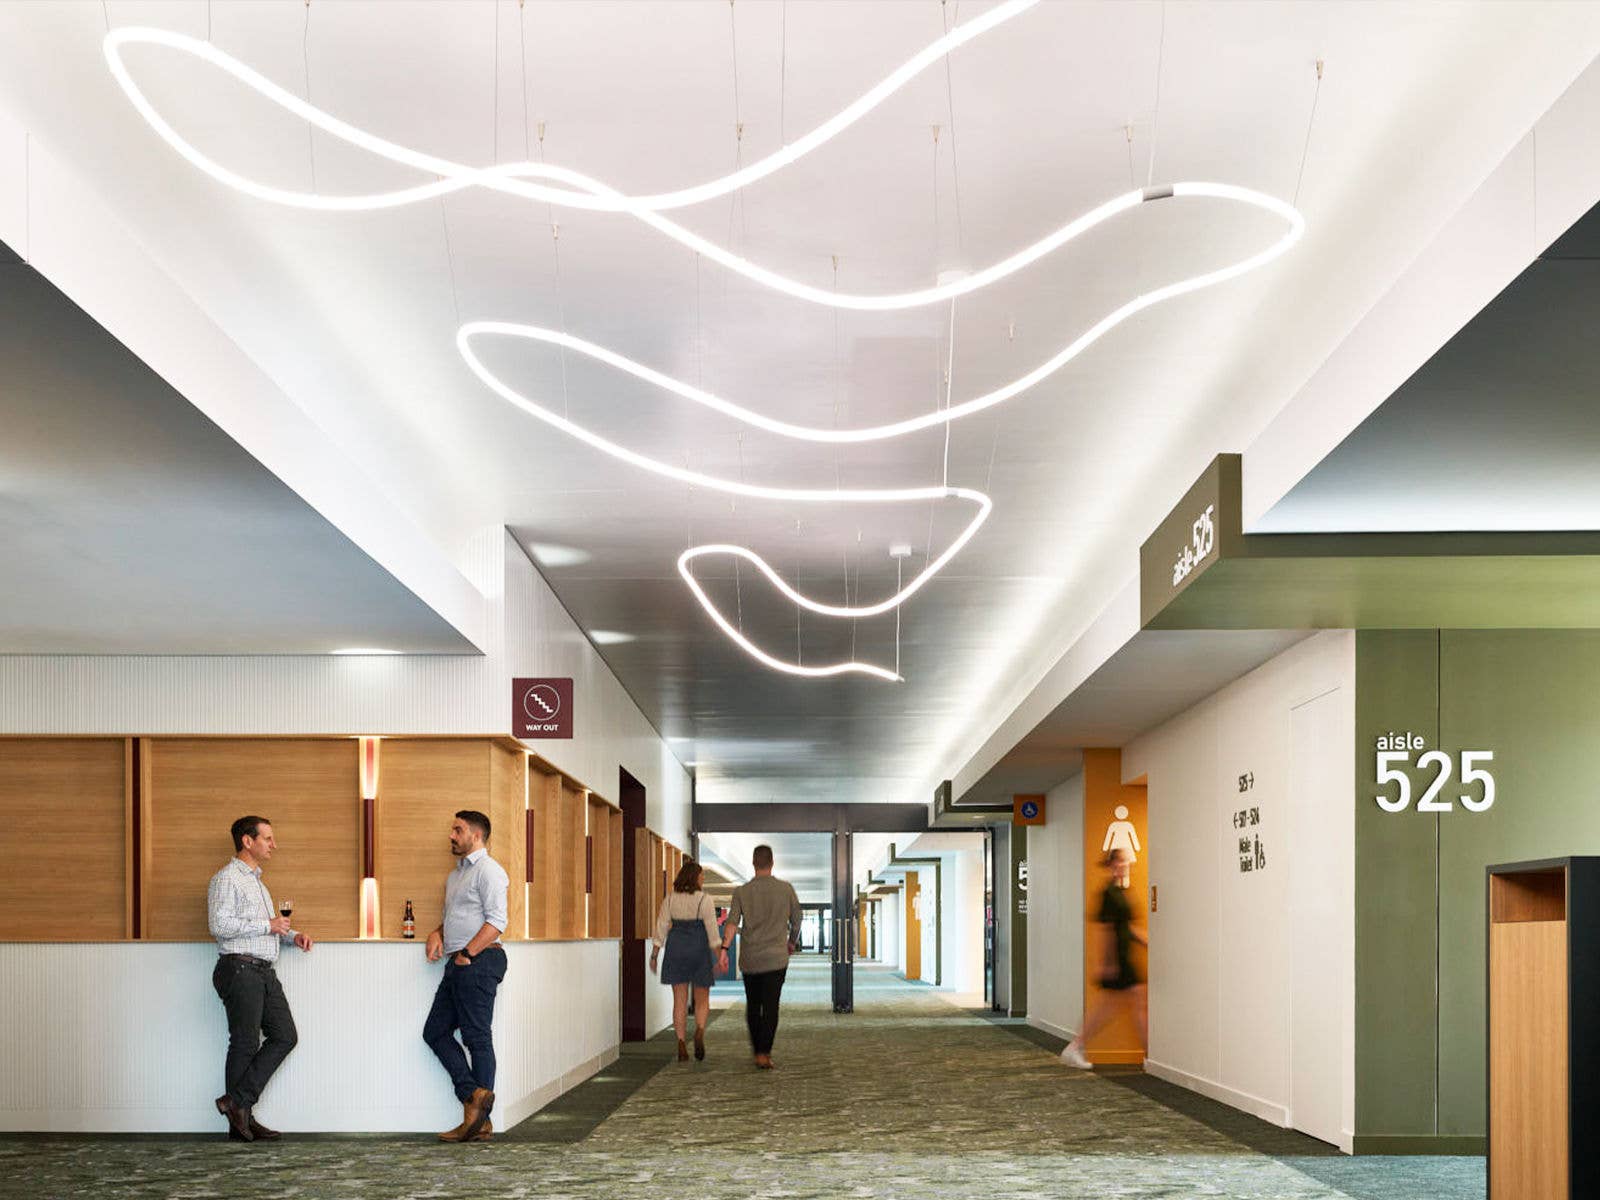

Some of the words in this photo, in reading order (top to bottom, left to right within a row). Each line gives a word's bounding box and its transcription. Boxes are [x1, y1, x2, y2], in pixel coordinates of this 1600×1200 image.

[1193, 504, 1214, 567] 525
[1377, 732, 1425, 750] aisle
[1376, 750, 1496, 812] 525
